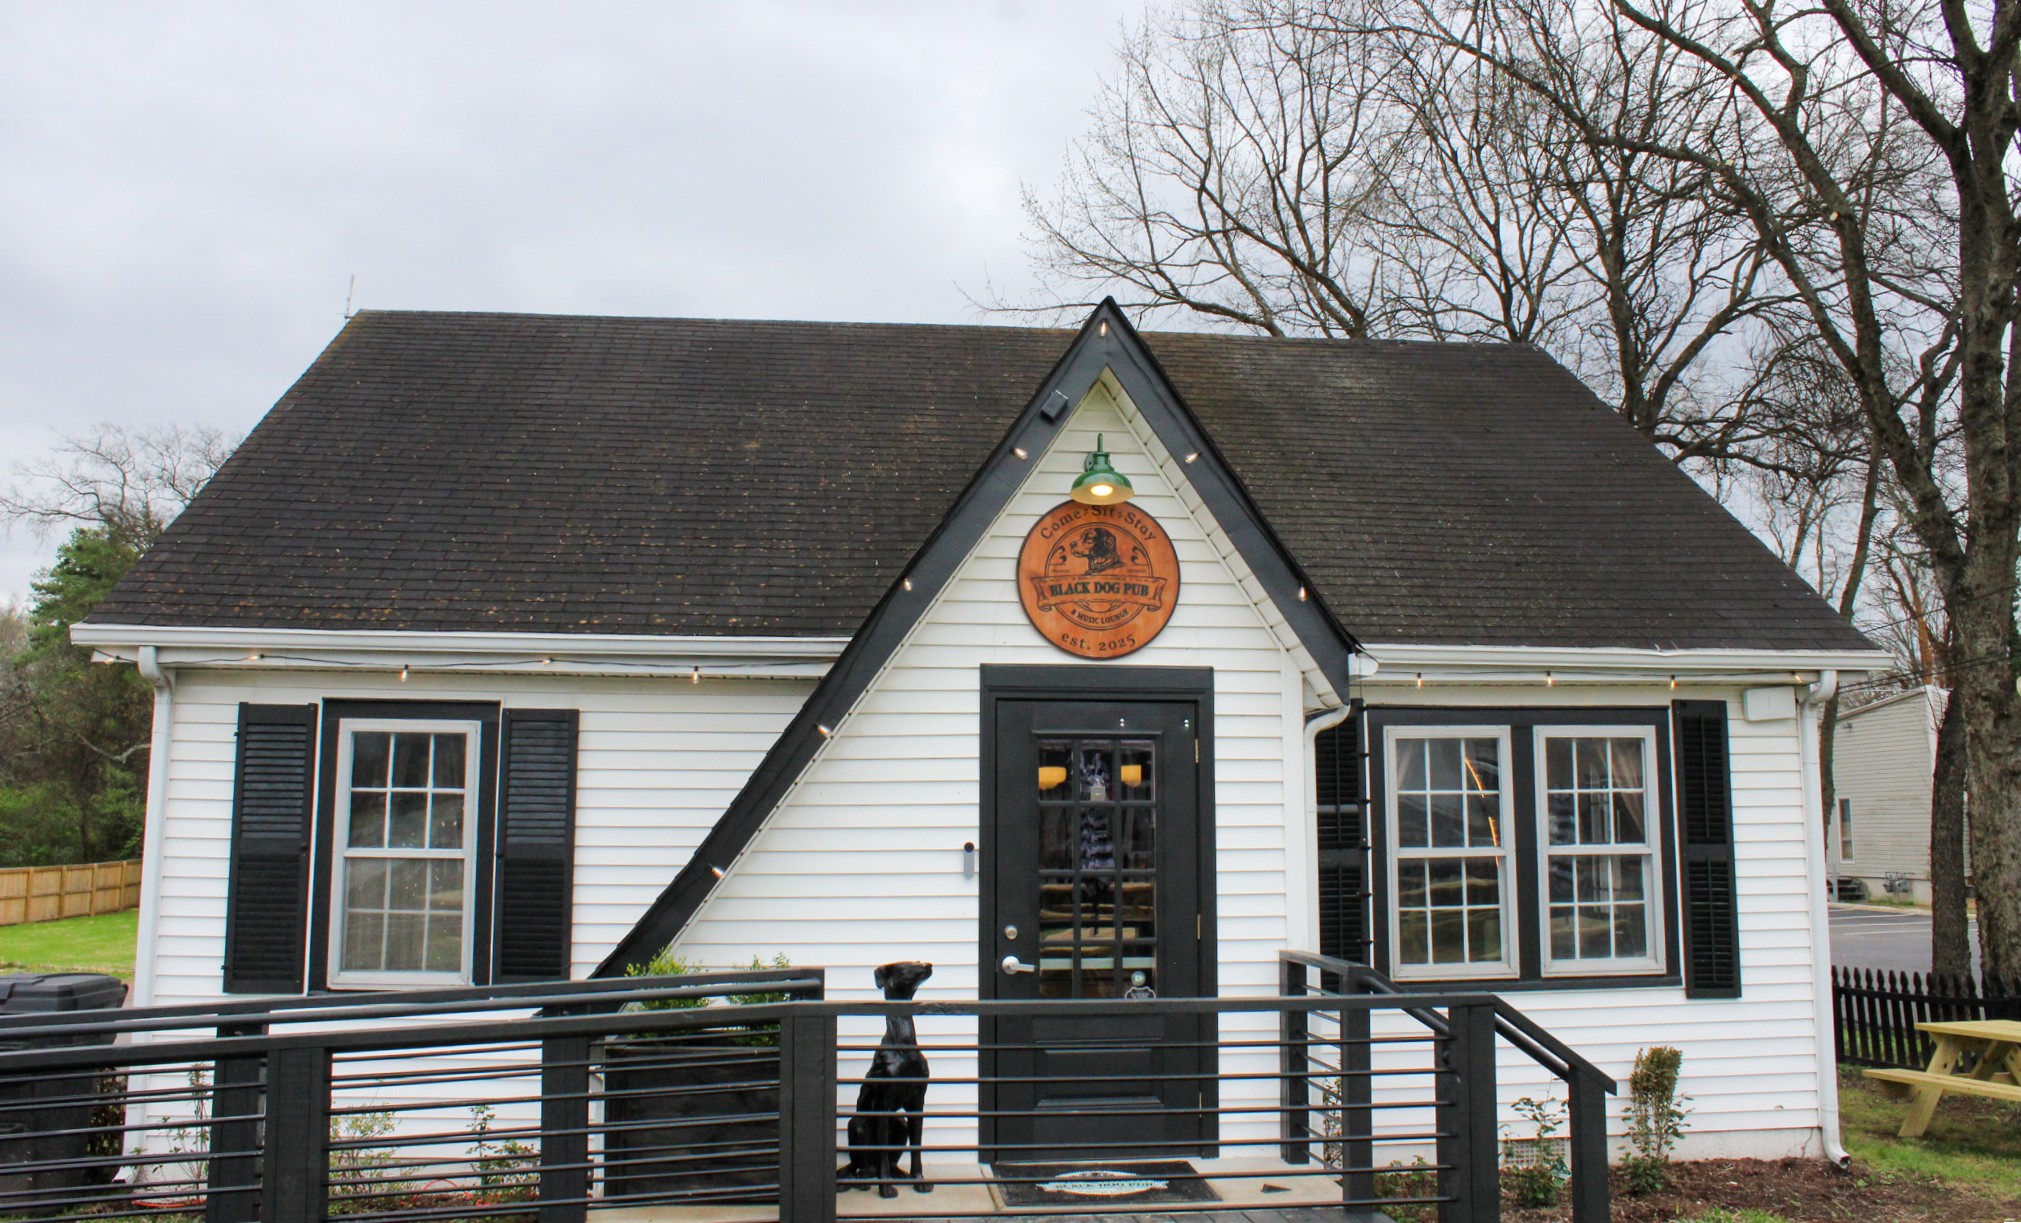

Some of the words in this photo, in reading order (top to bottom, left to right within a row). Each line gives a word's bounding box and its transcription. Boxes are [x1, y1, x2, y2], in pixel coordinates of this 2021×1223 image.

[1040, 510, 1082, 539] Come
[1091, 505, 1115, 517] Sit
[1124, 511, 1157, 541] Stay
[1050, 581, 1091, 597] BLACK
[1094, 581, 1120, 594] DOG
[1123, 582, 1150, 597] PUB
[1077, 612, 1100, 625] MUSIC
[1101, 608, 1130, 625] LOUNGE
[1061, 633, 1091, 650] est.
[1098, 633, 1137, 651] 2025
